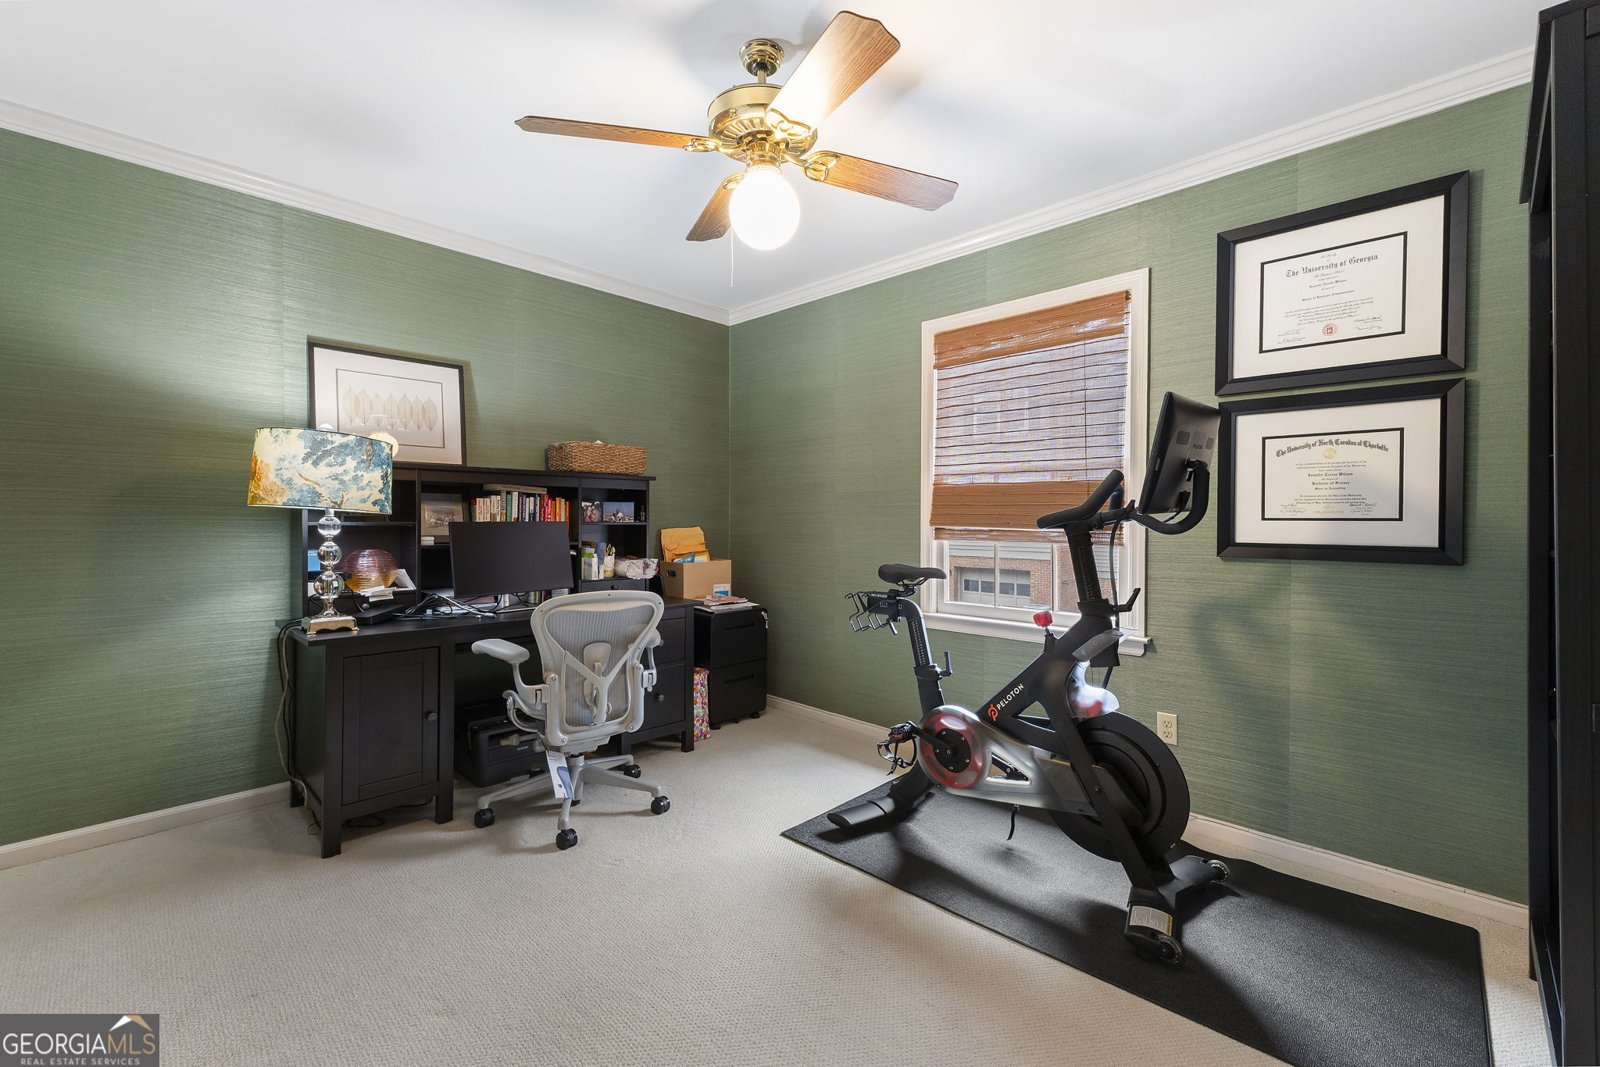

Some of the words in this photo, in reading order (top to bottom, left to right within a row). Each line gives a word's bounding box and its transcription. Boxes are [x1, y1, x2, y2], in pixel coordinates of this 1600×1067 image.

[1302, 262, 1337, 274] University
[1349, 255, 1378, 264] Georgia
[1276, 449, 1286, 457] The
[1287, 442, 1311, 453] University
[1363, 440, 1389, 452] Charlotte
[996, 683, 1024, 710] PELOTON
